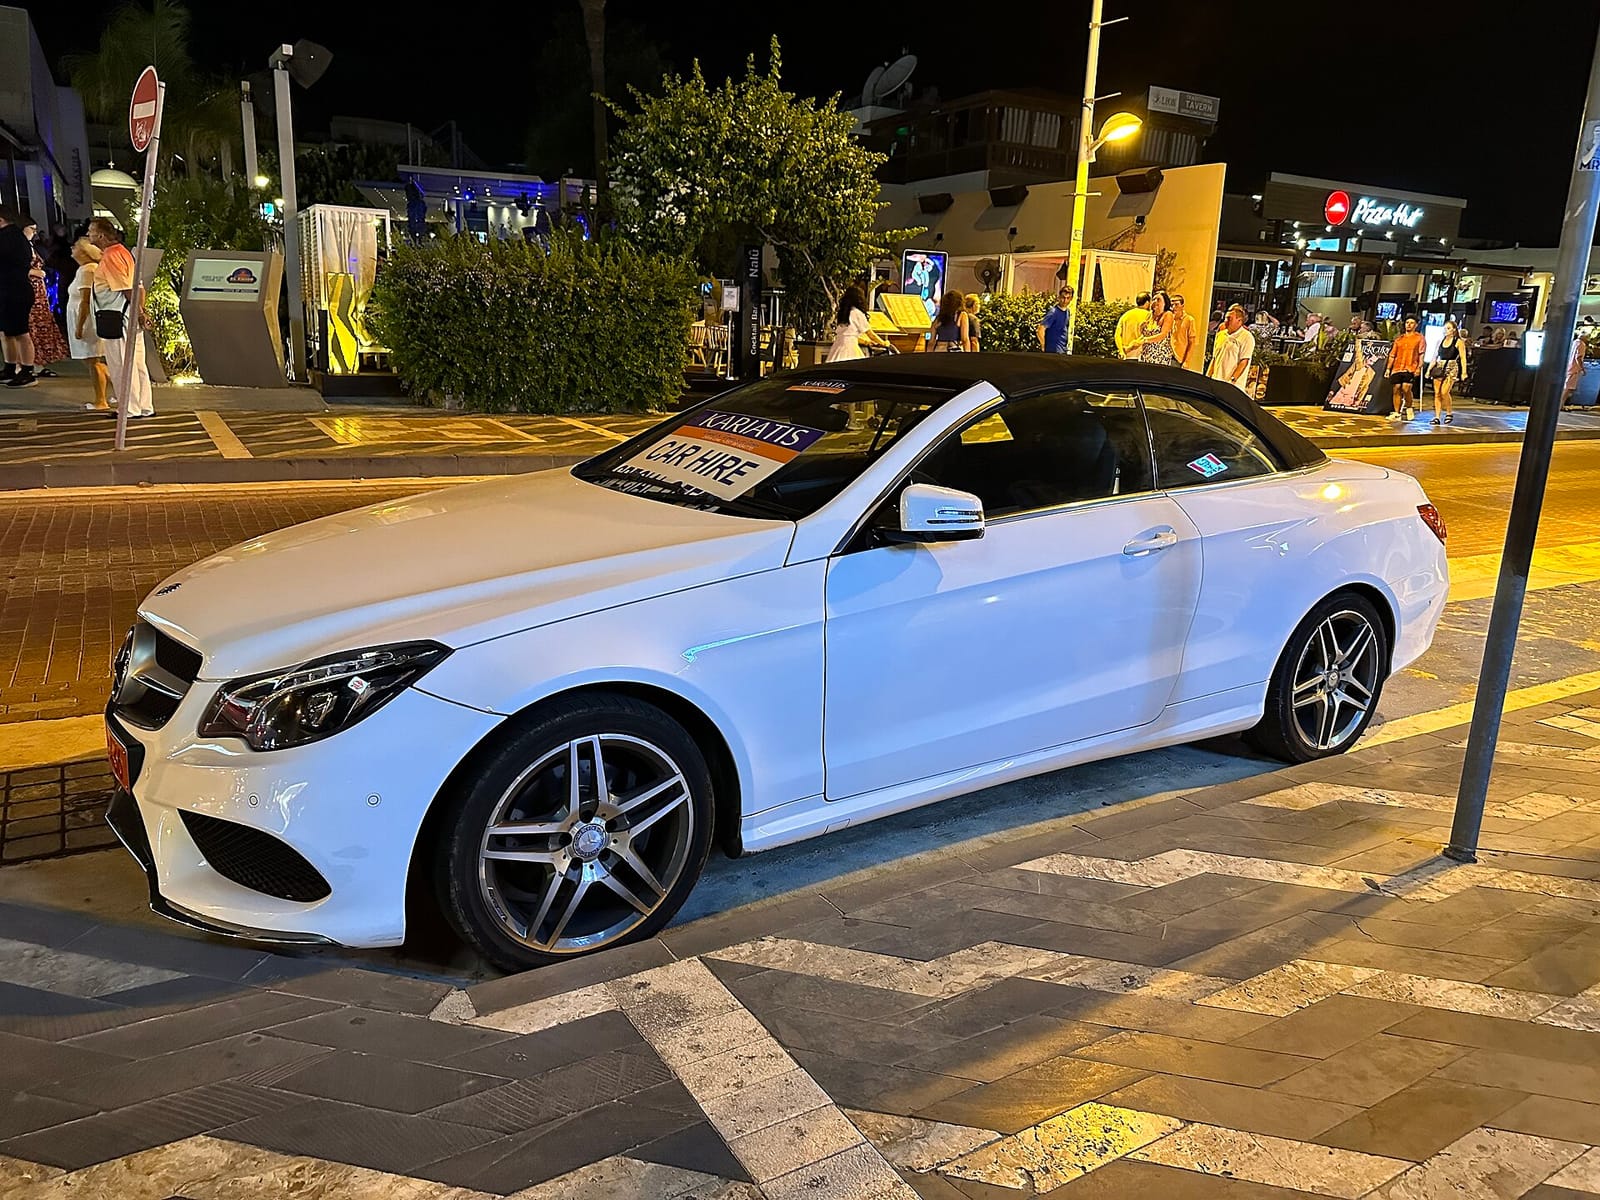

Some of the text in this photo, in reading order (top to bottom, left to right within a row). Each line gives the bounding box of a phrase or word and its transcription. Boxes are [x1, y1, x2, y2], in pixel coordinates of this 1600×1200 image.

[1185, 100, 1213, 113] TAVERN
[1350, 197, 1424, 228] Pizza Hut
[750, 323, 758, 356] Cocktail
[699, 412, 809, 446] KARIATIS
[645, 440, 702, 469] CAR
[683, 448, 760, 487] HIRE
